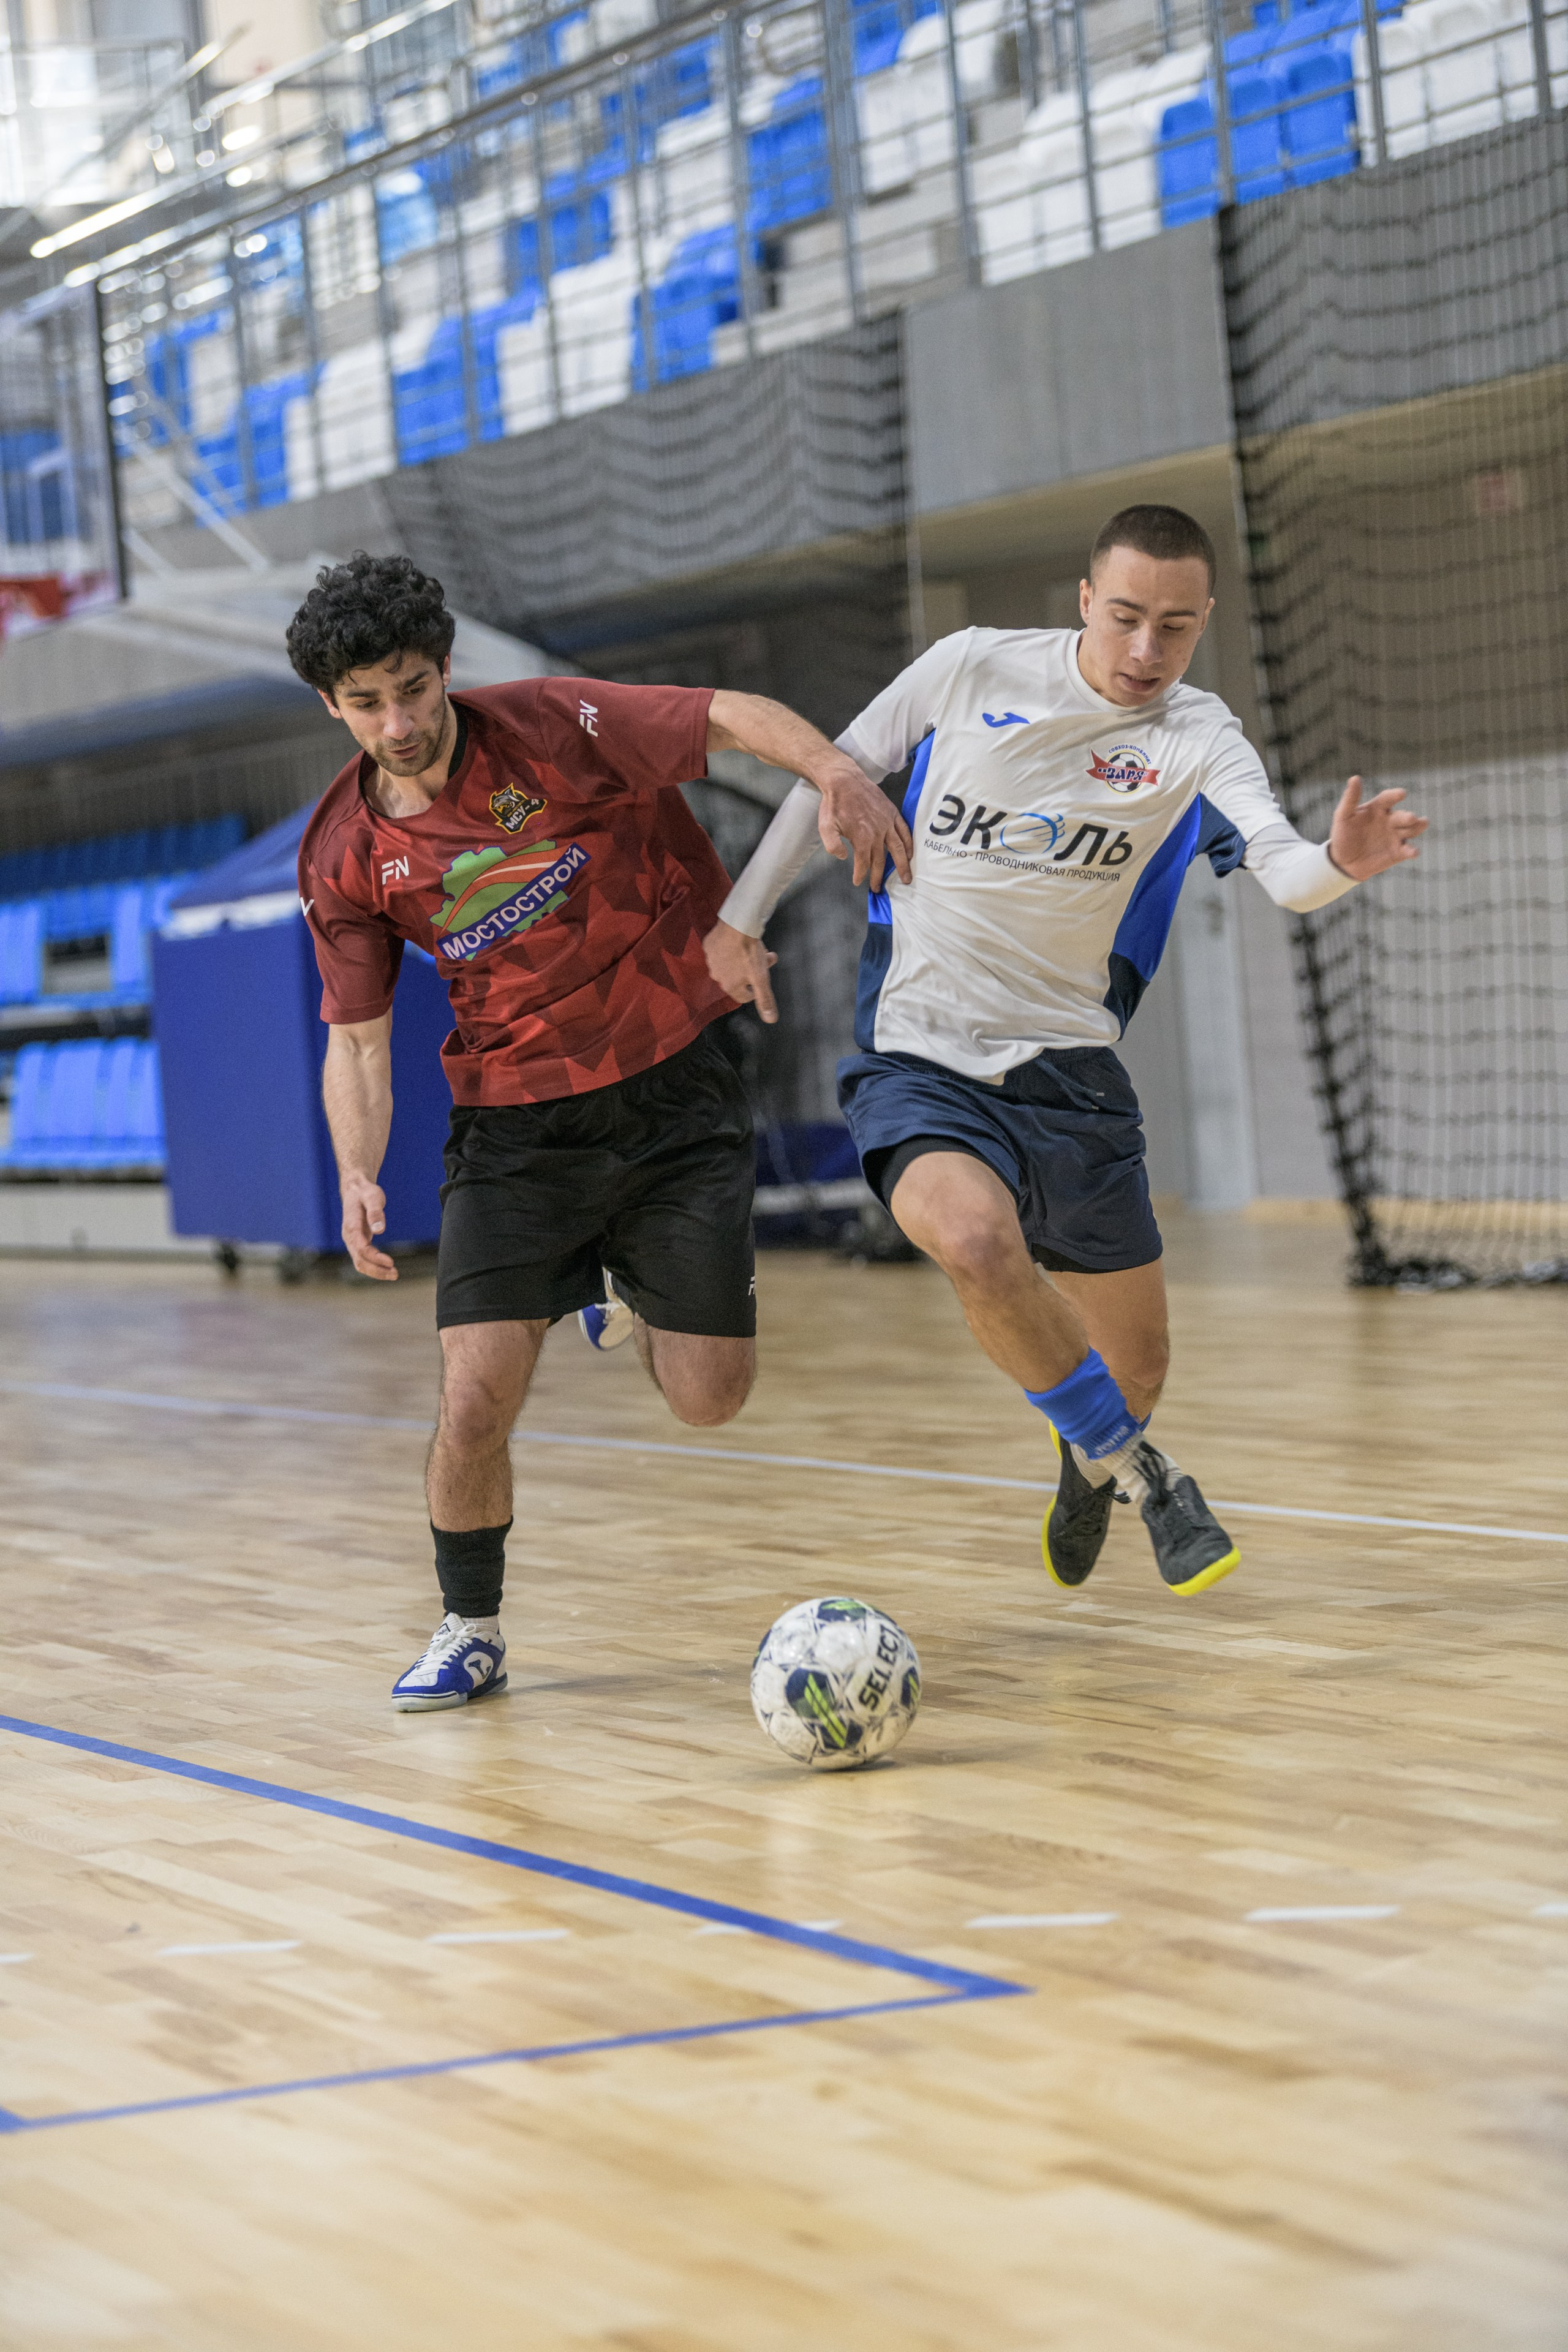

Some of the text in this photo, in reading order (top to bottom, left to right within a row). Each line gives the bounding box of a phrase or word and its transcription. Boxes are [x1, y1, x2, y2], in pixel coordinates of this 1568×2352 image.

[579, 699, 598, 737] FN
[382, 856, 409, 885] FN
[924, 839, 967, 858] КАБЕЛЬНО
[975, 851, 1065, 876] ПРОВОДНИКОВАЯ
[1066, 869, 1120, 881] ПРОДУКЦИЯ
[442, 848, 586, 960] МОСТОСТРОЙ
[859, 1624, 899, 1711] SELECT
